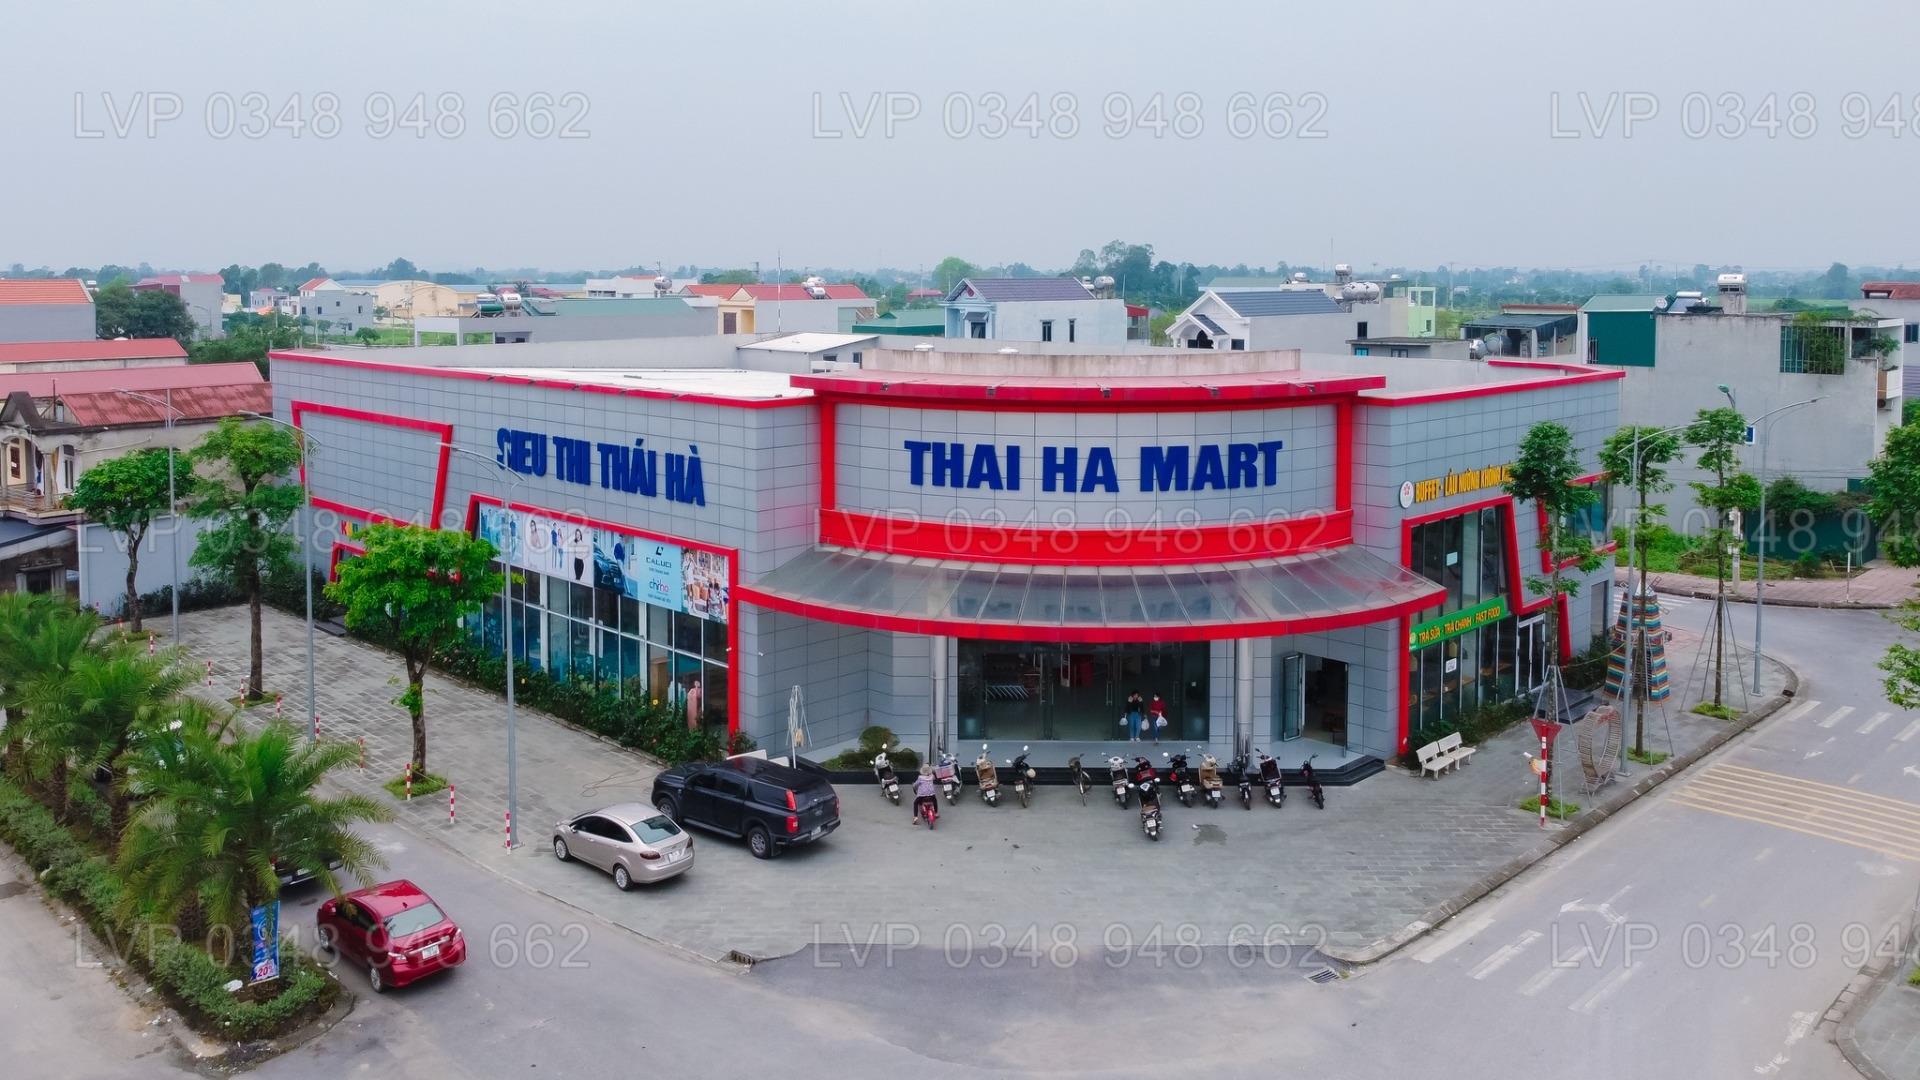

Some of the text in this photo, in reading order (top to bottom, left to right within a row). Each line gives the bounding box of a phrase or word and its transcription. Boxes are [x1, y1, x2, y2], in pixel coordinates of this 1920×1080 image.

[597, 437, 657, 497] THÁI
[664, 444, 706, 507] HÀ
[904, 440, 1284, 493] THAI HA MART
[646, 556, 672, 569] CALUCI
[1475, 611, 1487, 624] FAST
[1488, 606, 1500, 620] FOOD
